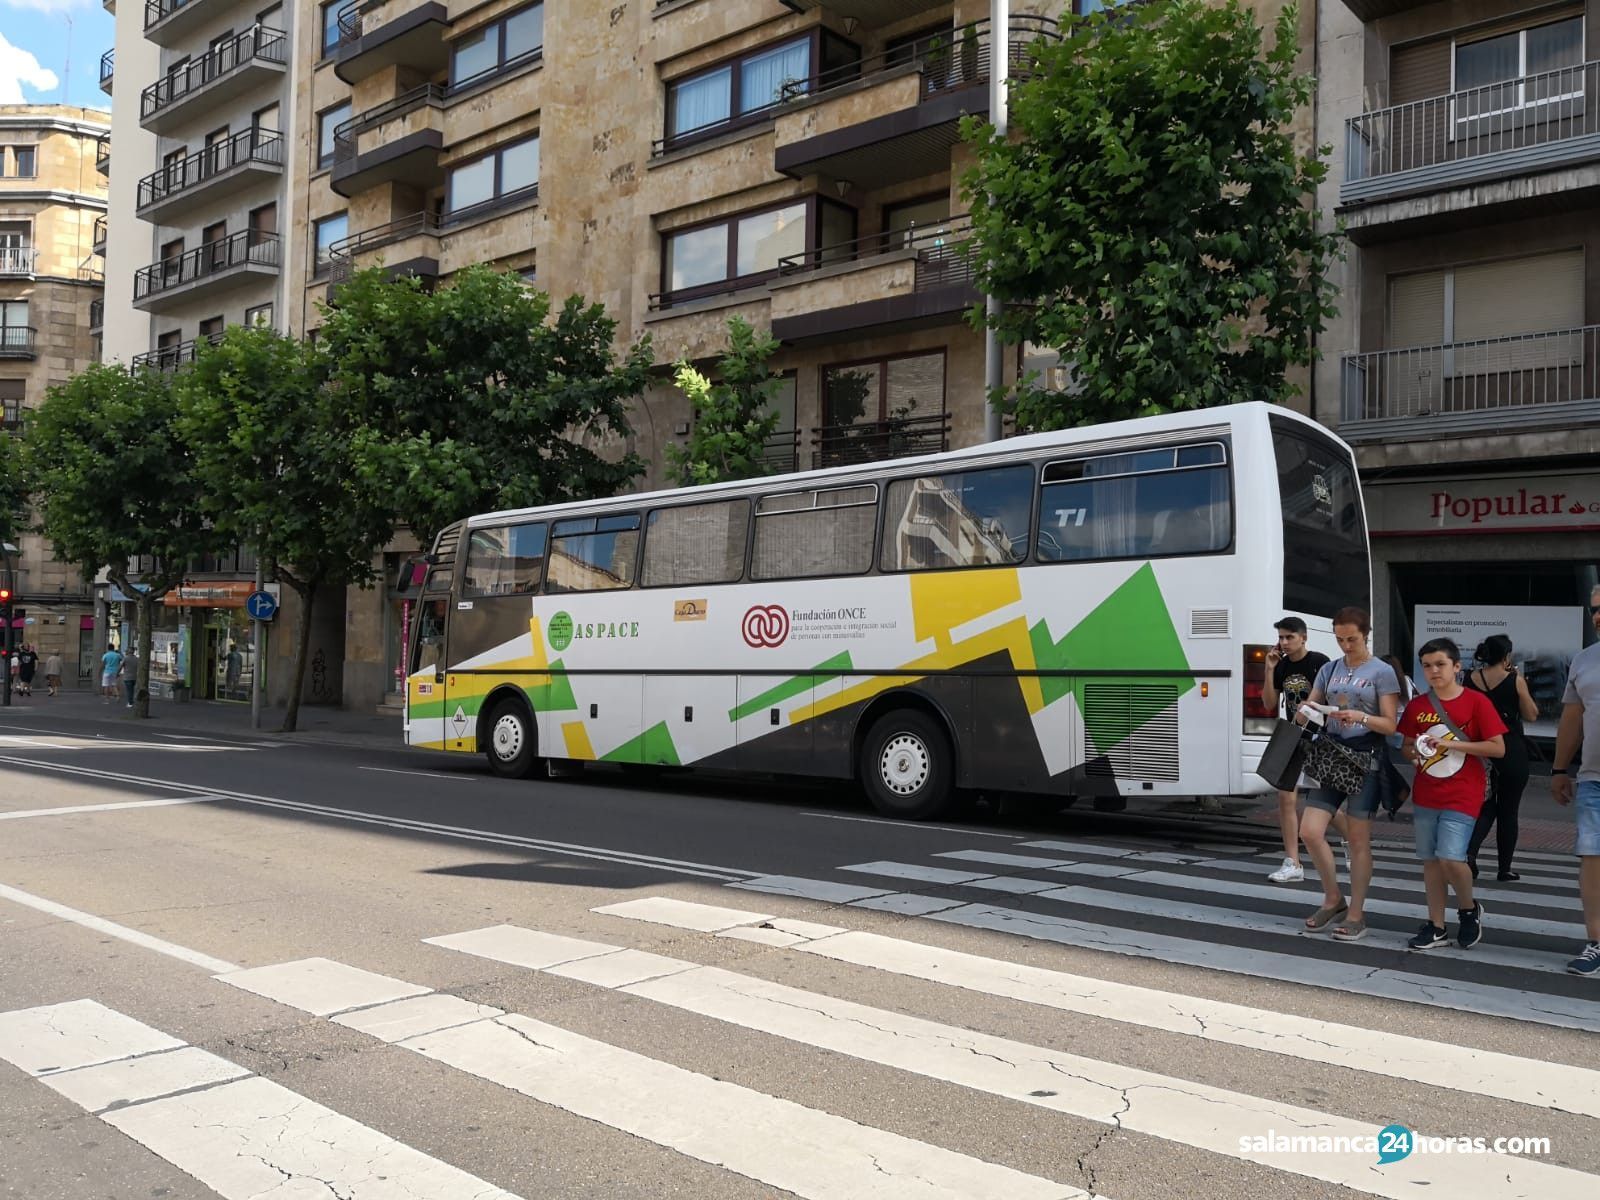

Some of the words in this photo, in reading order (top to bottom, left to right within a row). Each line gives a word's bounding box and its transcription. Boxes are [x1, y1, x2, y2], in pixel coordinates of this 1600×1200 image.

[1430, 489, 1567, 523] Popular
[792, 609, 836, 621] Fundación
[837, 607, 867, 619] ONCE
[574, 622, 639, 639] ASPACE
